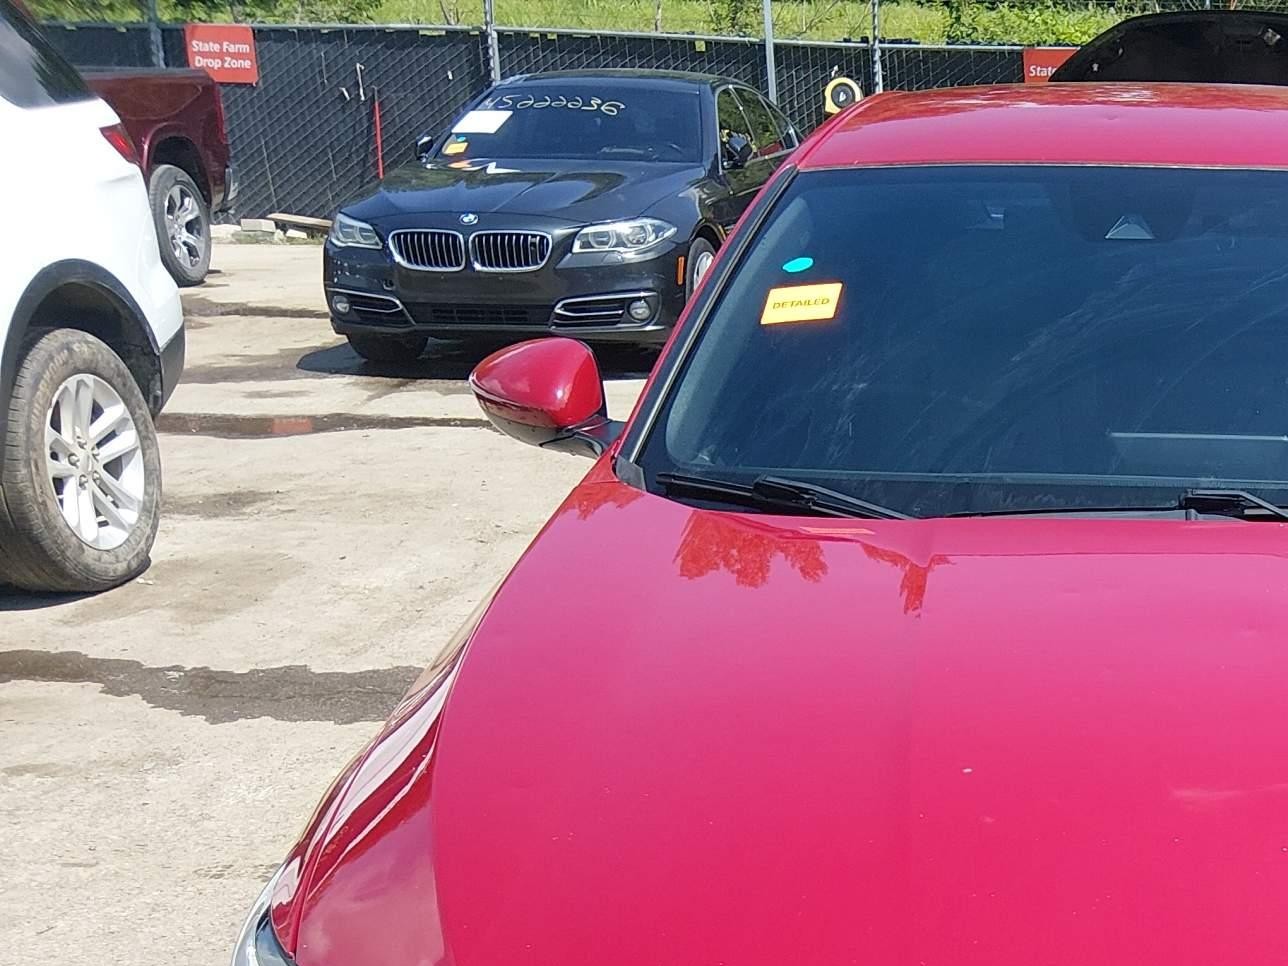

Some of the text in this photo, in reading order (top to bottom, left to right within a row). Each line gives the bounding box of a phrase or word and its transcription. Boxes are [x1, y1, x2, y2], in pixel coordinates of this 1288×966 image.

[191, 40, 250, 53] State Farm
[194, 55, 251, 70] Drop Zone
[772, 298, 831, 310] DETAILED
